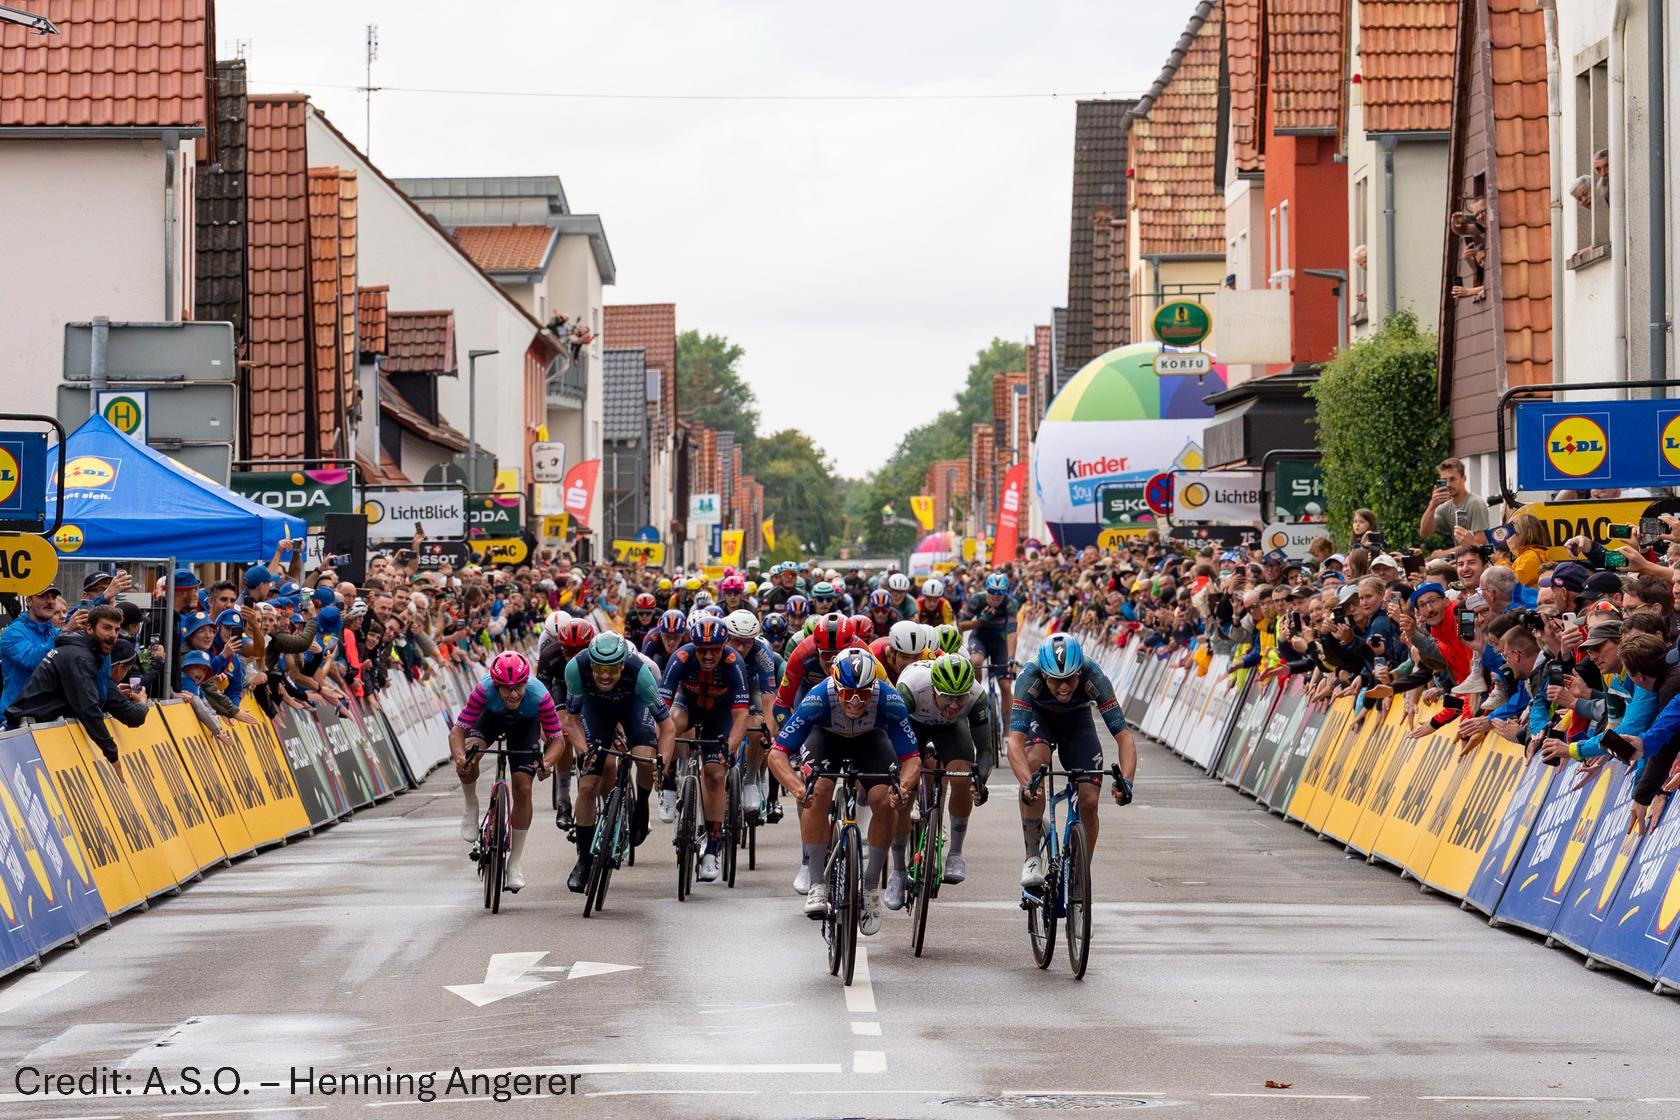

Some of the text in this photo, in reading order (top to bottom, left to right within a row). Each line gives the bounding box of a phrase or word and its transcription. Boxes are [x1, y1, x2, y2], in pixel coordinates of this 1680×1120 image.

[1161, 360, 1204, 370] KORFU
[390, 505, 460, 521] LichtBlick
[779, 716, 806, 740] BOSS
[899, 717, 918, 745] BOSS
[1394, 734, 1456, 828] ADAC
[56, 766, 120, 870] ADAC
[1448, 751, 1525, 855] ADAC
[1630, 852, 1669, 900] TEAM
